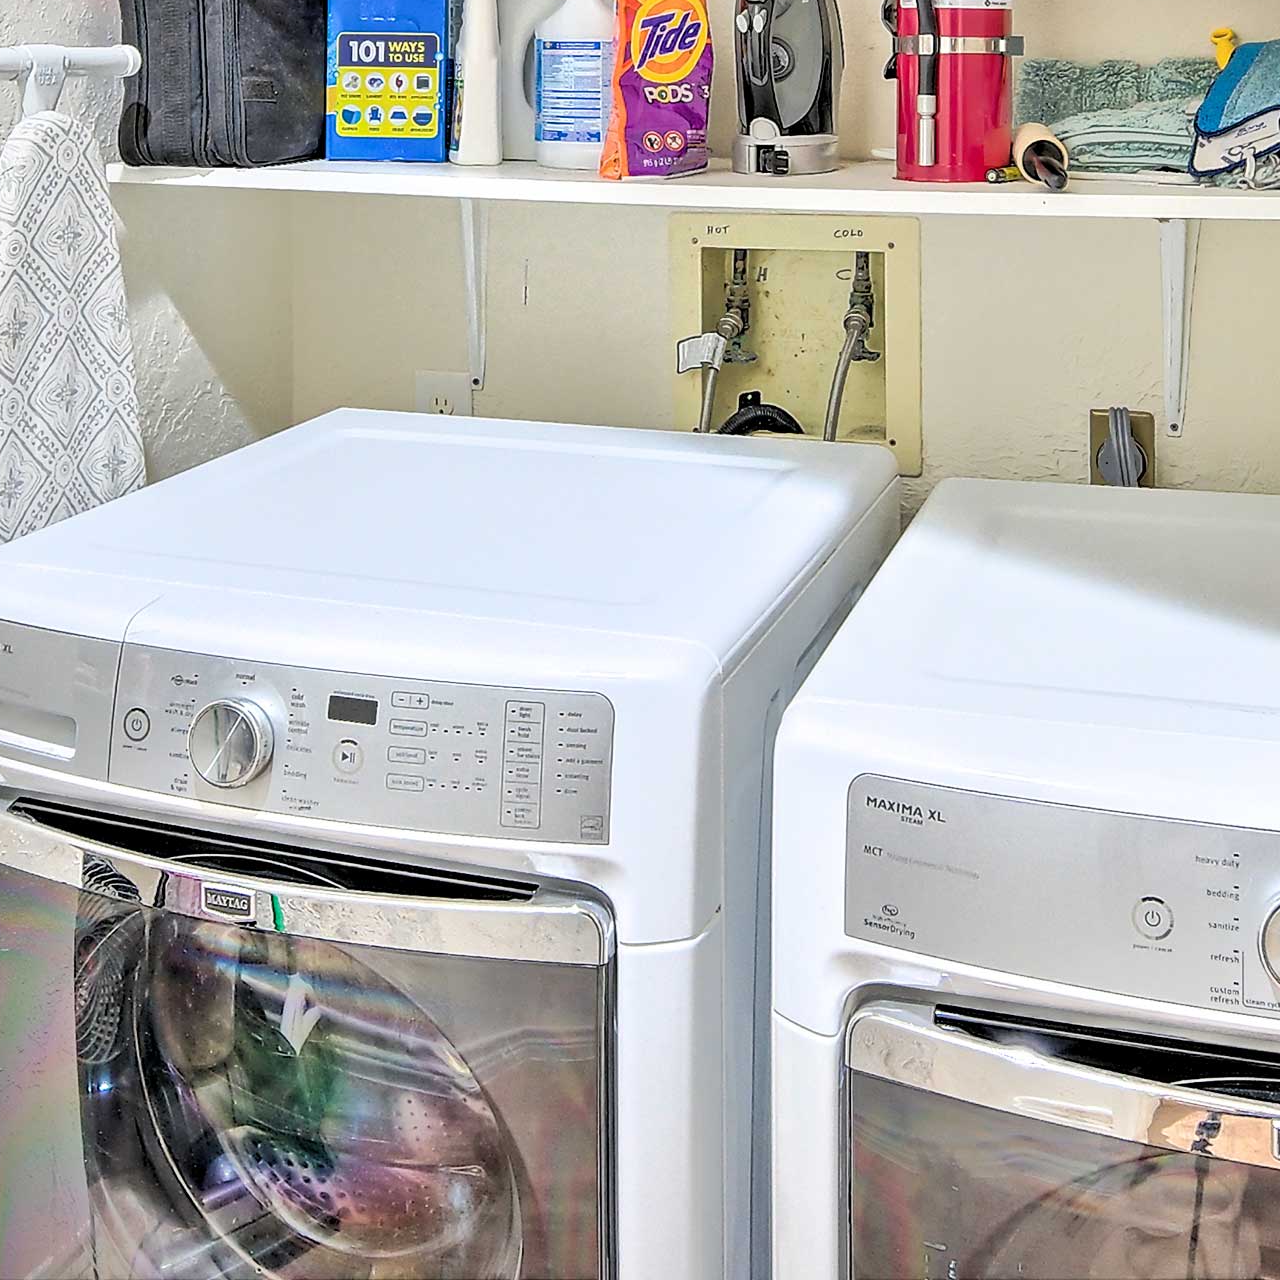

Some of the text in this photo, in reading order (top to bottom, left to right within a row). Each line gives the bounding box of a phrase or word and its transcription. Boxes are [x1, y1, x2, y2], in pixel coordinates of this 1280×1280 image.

[636, 9, 702, 70] Tide
[349, 40, 385, 63] 101
[389, 42, 425, 52] WAYS
[389, 54, 425, 62] TO USE
[643, 84, 694, 104] PODS
[707, 225, 863, 238] HOT COLD
[757, 267, 852, 282] H C
[2, 643, 14, 654] XL
[235, 673, 255, 681] normal
[866, 795, 947, 823] MAXIMA XL
[901, 816, 923, 825] STEAM
[864, 845, 884, 857] MCT
[1195, 856, 1240, 869] heavy duty
[207, 892, 248, 910] MAYTAG
[1207, 889, 1240, 901] bedding
[864, 918, 915, 939] SensorDrying
[1208, 922, 1240, 932] sanitize
[1210, 954, 1240, 964] refresh
[1210, 986, 1240, 995] custom
[1210, 995, 1240, 1005] refresh
[1246, 999, 1266, 1007] steam
